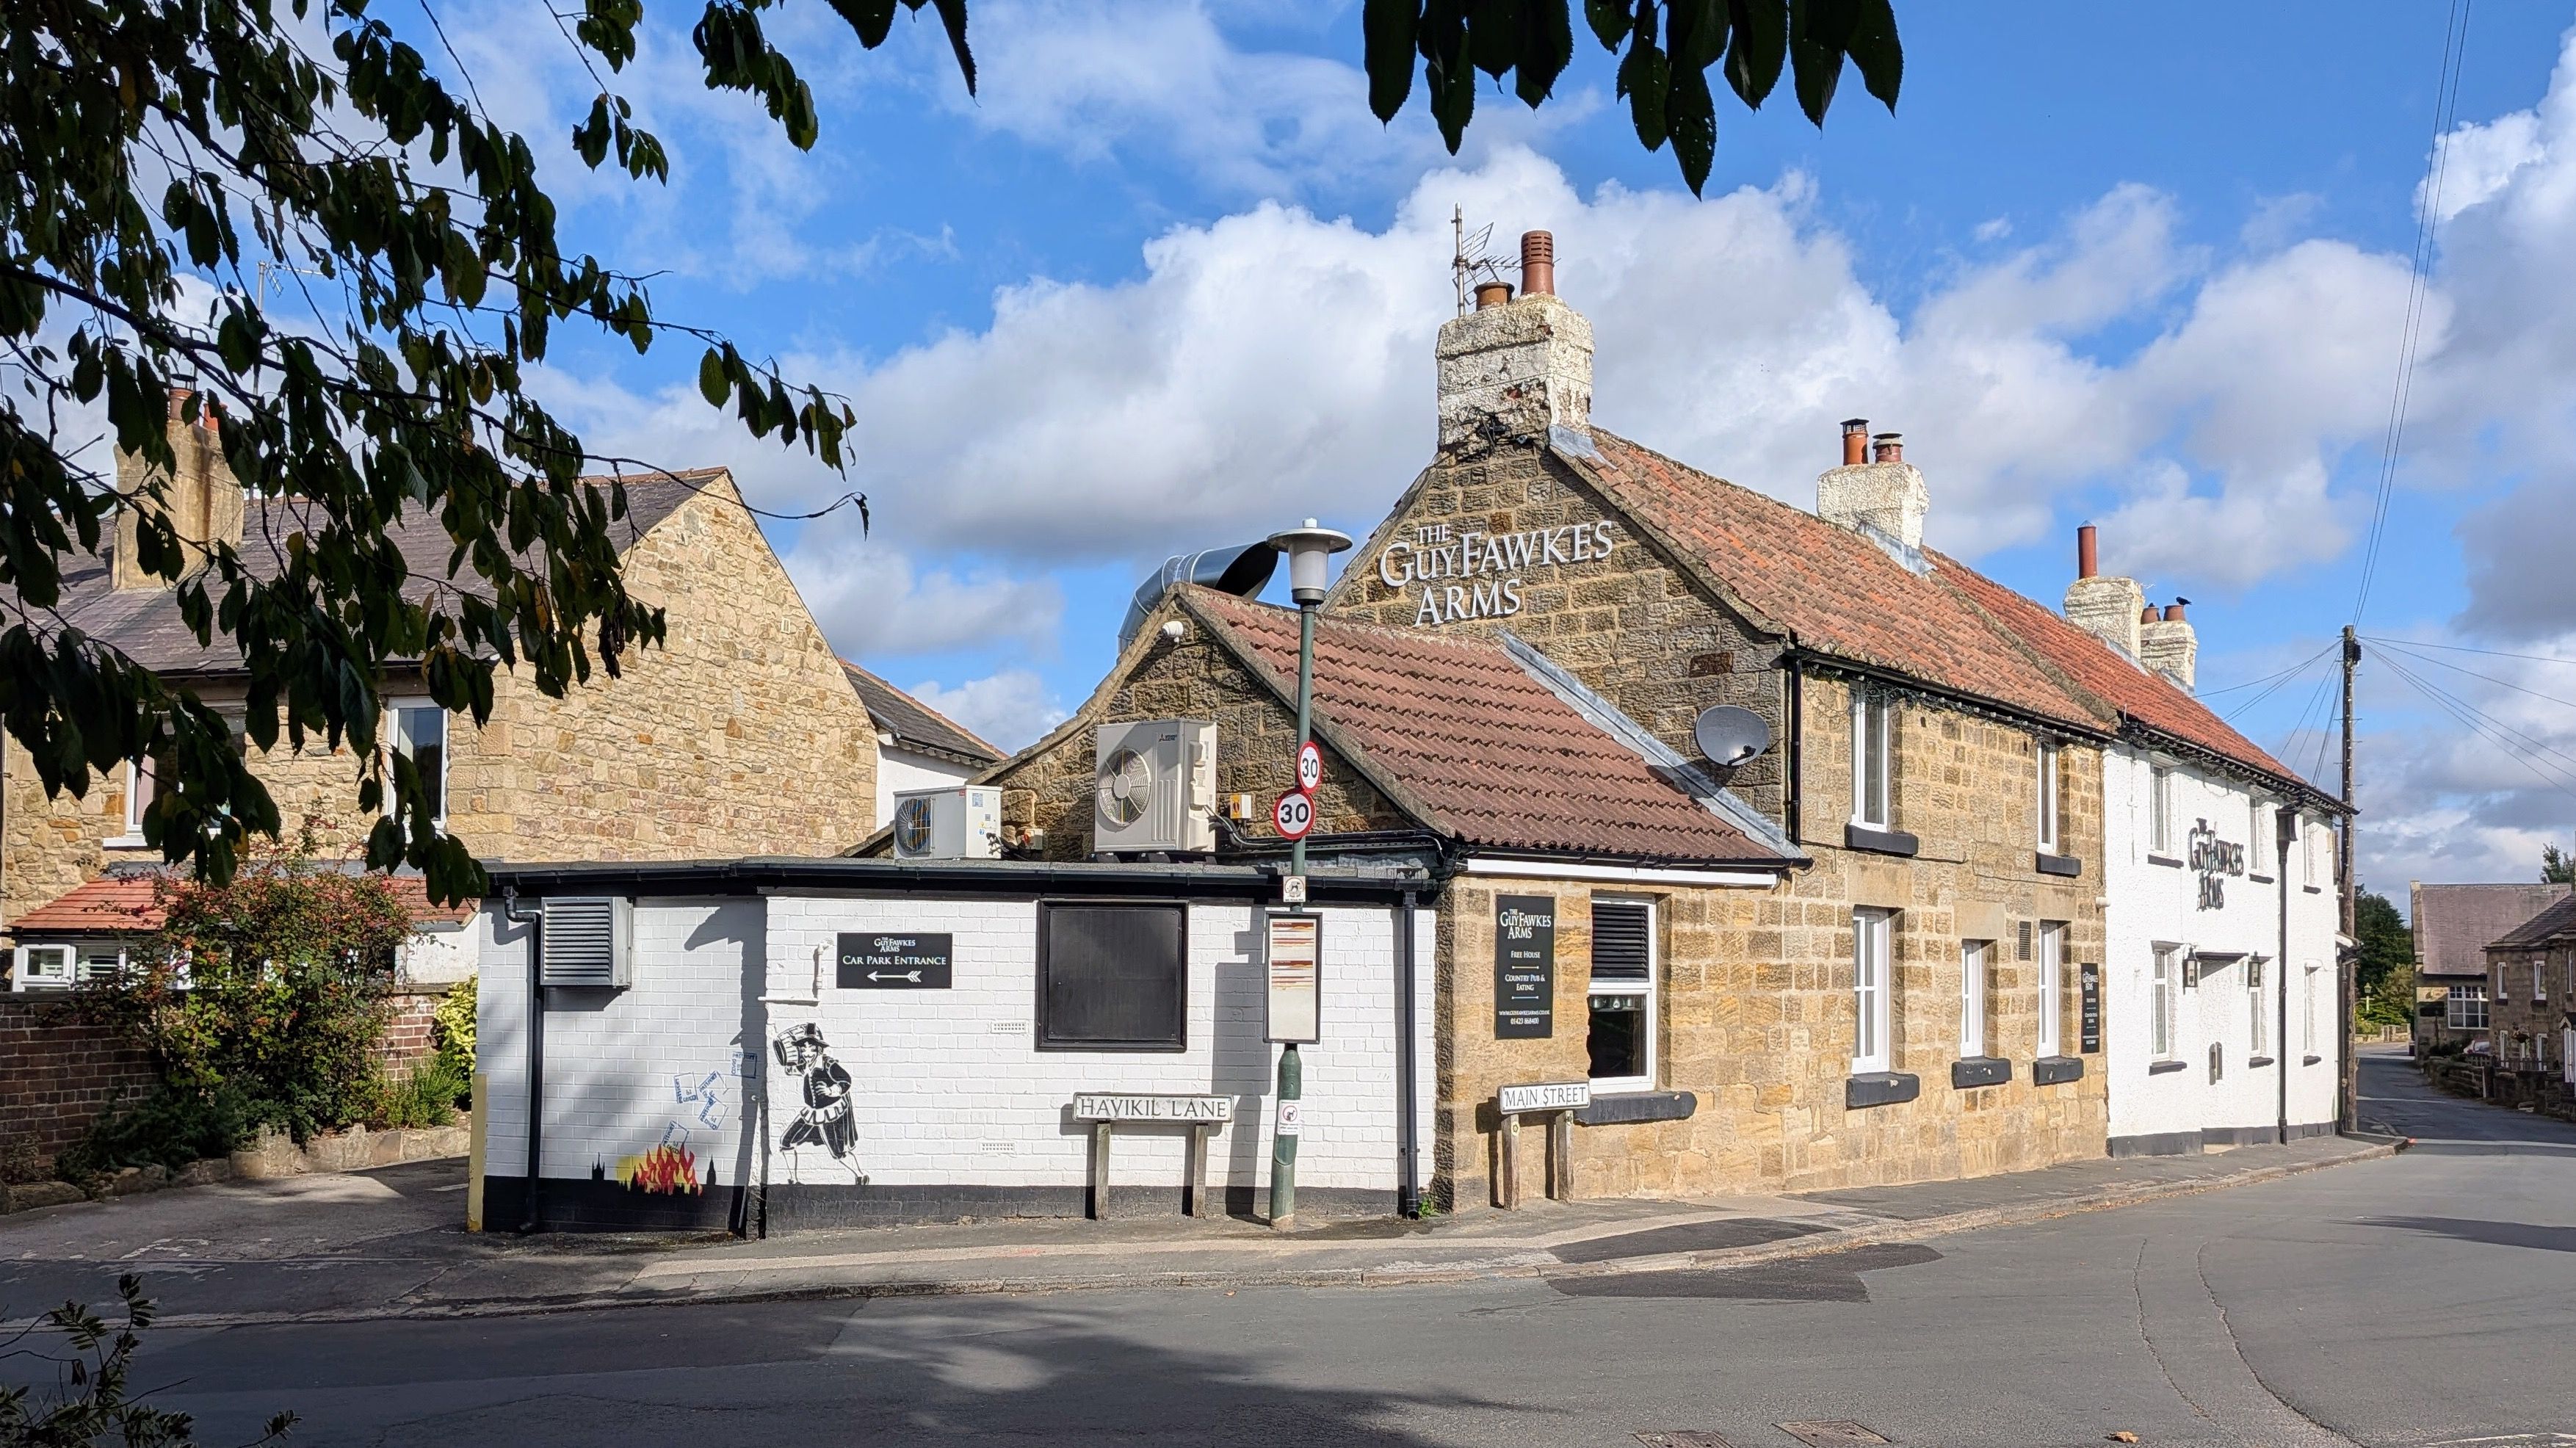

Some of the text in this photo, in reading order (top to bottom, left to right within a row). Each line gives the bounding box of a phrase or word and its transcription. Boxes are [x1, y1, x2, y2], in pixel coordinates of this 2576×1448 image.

[1417, 524, 1450, 545] THE
[1414, 579, 1521, 627] ARMS
[1302, 758, 1317, 778] 30
[1280, 803, 1309, 824] 30
[1508, 926, 1533, 939] ARMS
[842, 955, 947, 965] CAR PARK ENTRANCE
[1510, 950, 1541, 958] FREE HOUSE
[1505, 974, 1530, 982] COUNTRY
[1516, 983, 1535, 991] EATING
[1504, 1087, 1586, 1107] MAIN STREET
[1080, 1098, 1226, 1117] HAVIKIL LANE
